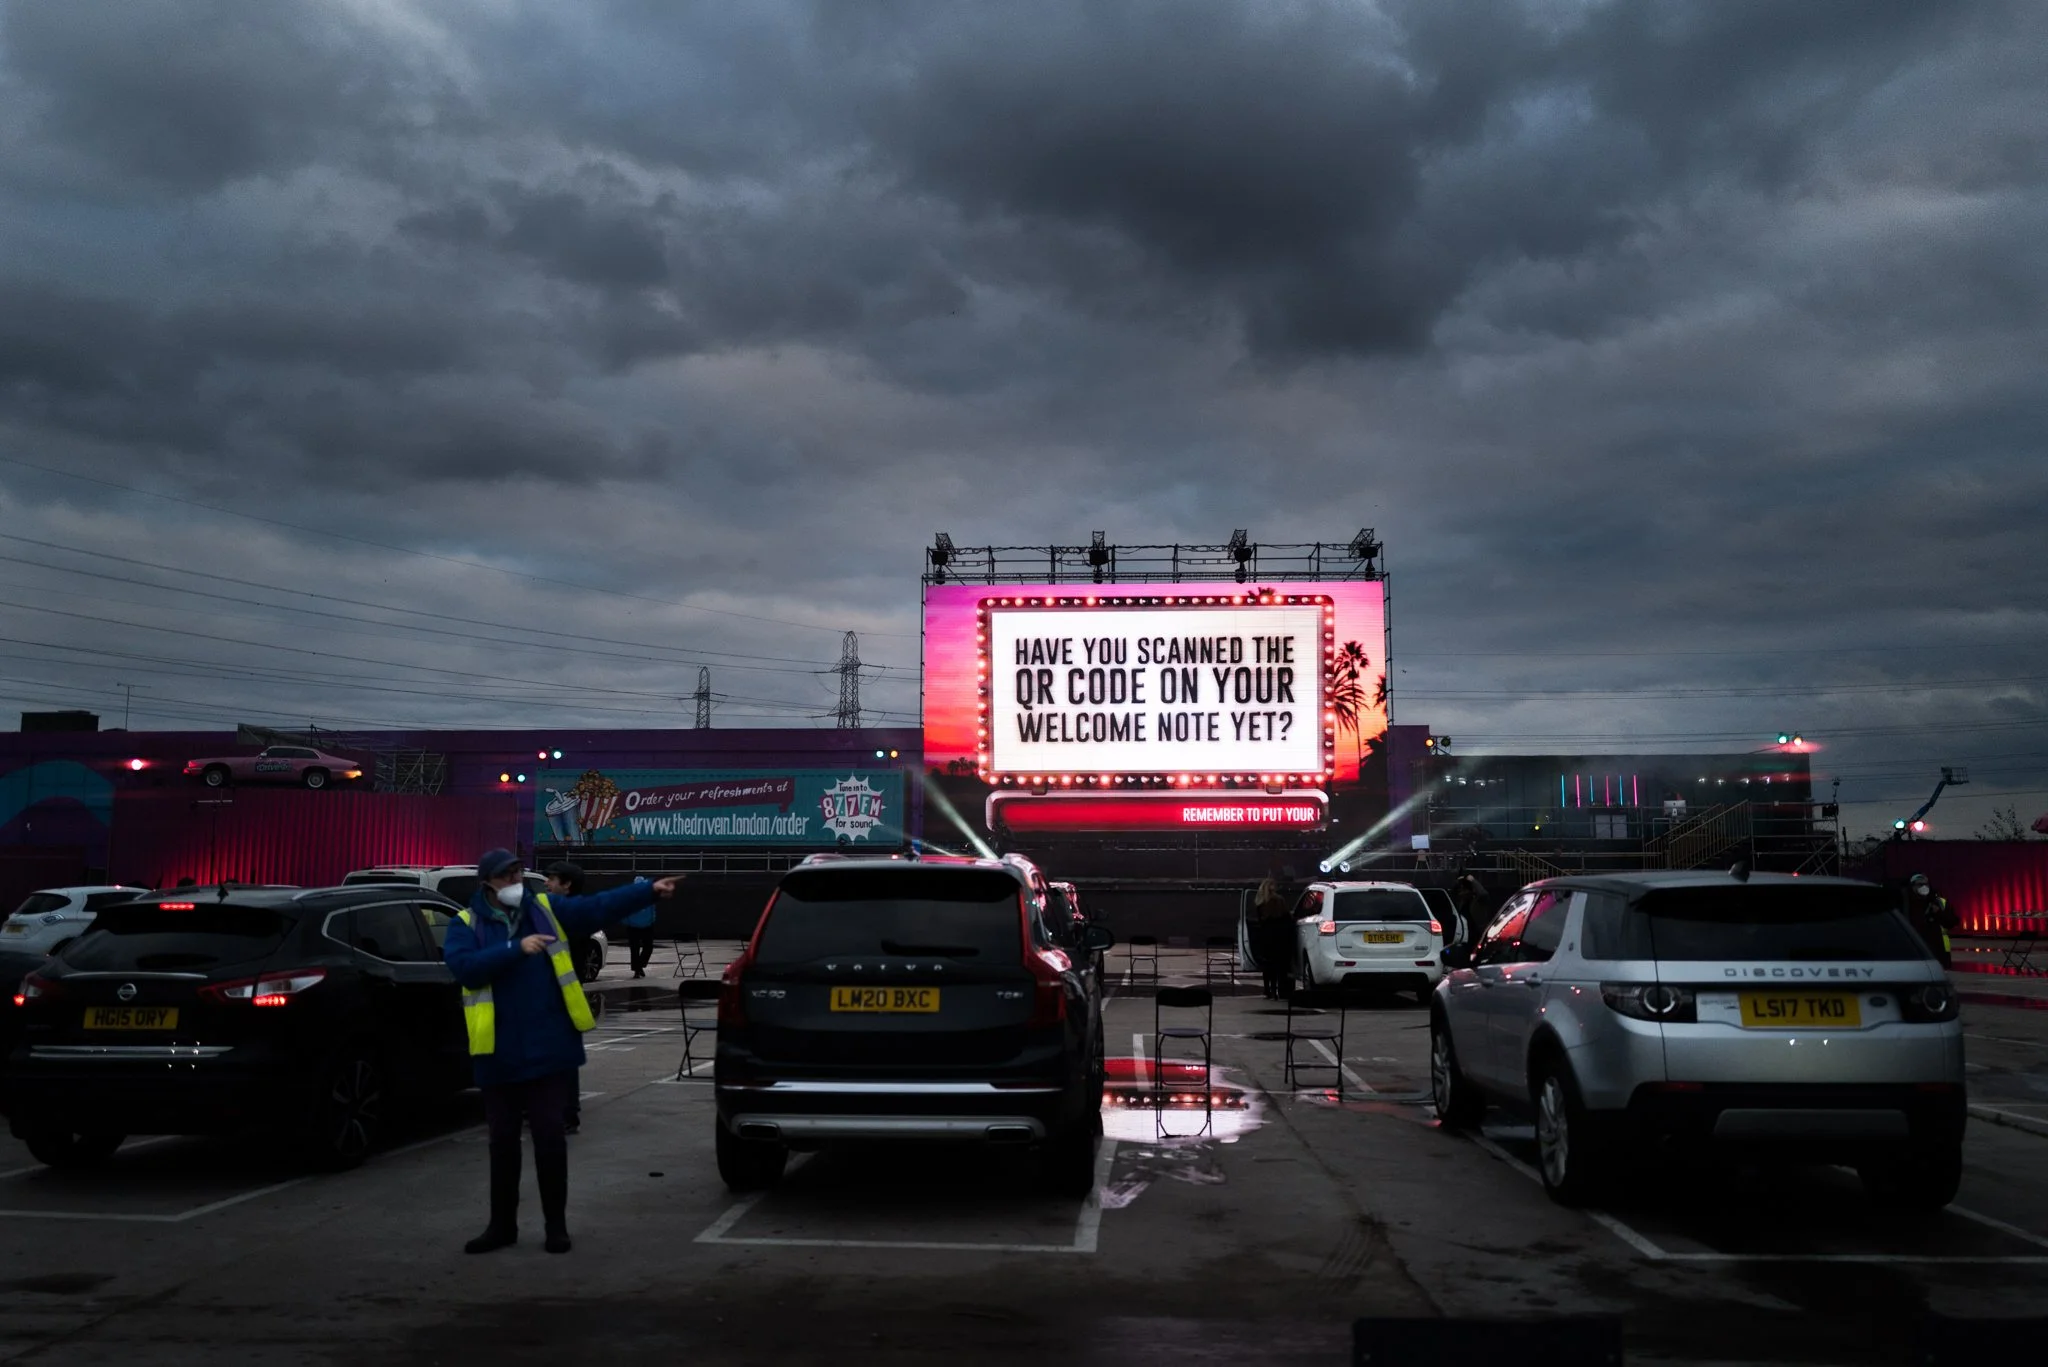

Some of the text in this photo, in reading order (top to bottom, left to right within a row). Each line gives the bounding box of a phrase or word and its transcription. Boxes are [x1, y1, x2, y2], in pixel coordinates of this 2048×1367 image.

[1015, 635, 1295, 665] HAVE YOU SCANNED THE
[1015, 666, 1295, 710] QR CODE ON YOUR
[1017, 711, 1293, 743] WELCOME NOTE YET?
[625, 781, 788, 811] Order your refreshments at
[838, 783, 852, 792] Tune
[629, 812, 810, 836] www.thedrivein.london/order
[835, 817, 874, 828] for sound
[1183, 807, 1244, 822] REMEMBER
[1246, 807, 1260, 822] TO
[1262, 807, 1284, 822] PUT
[1285, 807, 1314, 822] YOUR
[1724, 968, 1875, 977] DISCOVERY
[837, 989, 931, 1008] LM20 BXC
[1753, 998, 1799, 1018] LS17
[1803, 998, 1845, 1018] TKD
[94, 1008, 132, 1027] HG15
